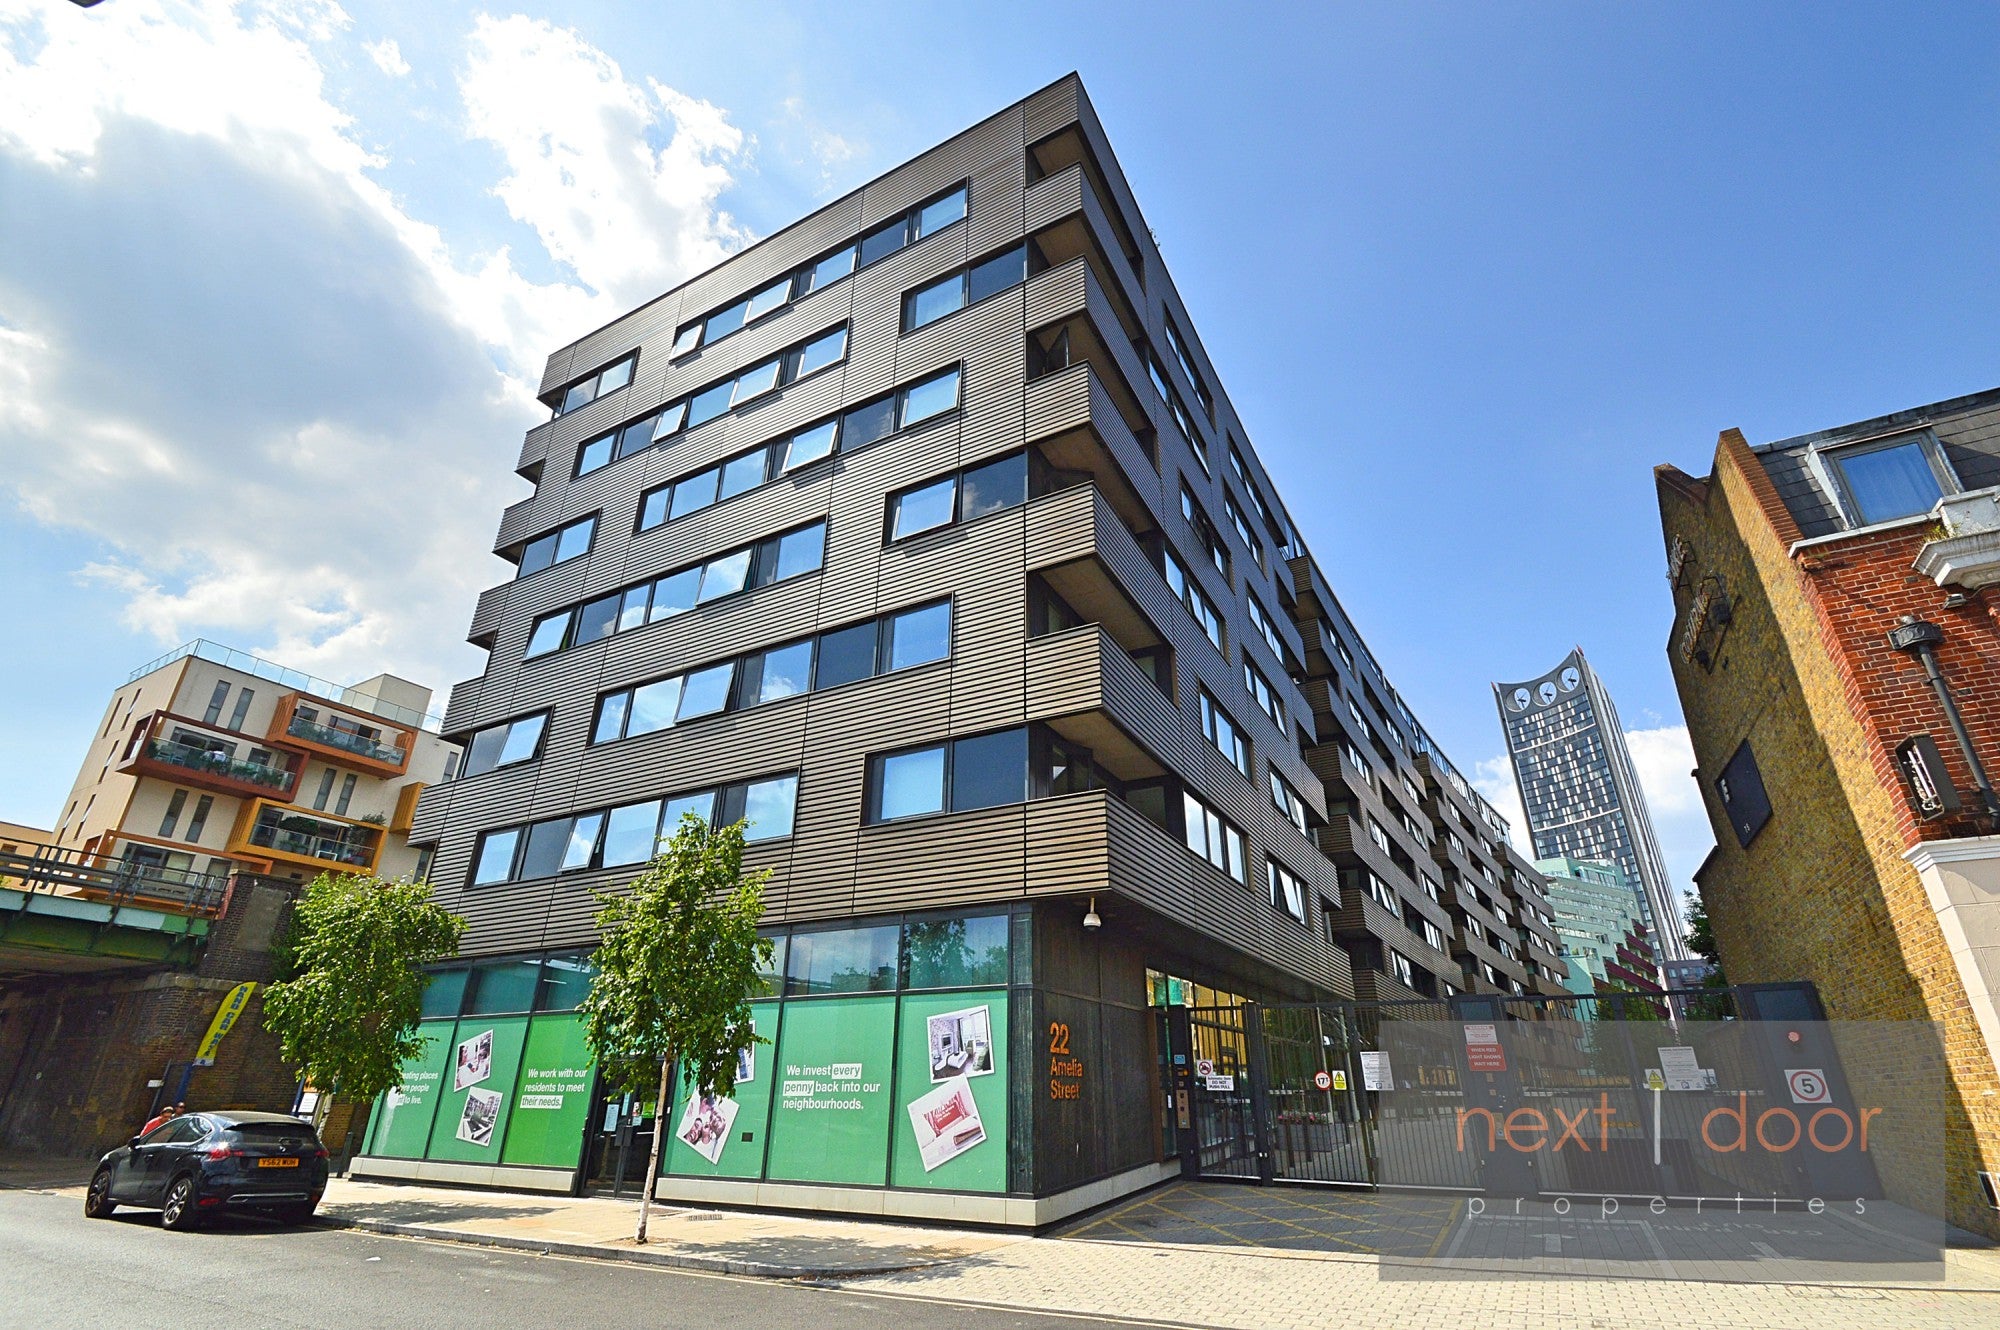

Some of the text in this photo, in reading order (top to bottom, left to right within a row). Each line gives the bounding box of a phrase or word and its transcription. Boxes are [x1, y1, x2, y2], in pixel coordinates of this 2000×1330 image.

[1050, 1022, 1070, 1054] 22
[528, 1068, 588, 1078] We work with our
[786, 1064, 860, 1077] We invest every
[1050, 1056, 1083, 1077] Amelia
[419, 1071, 439, 1080] places
[410, 1083, 430, 1093] people
[524, 1083, 586, 1092] residents to meet
[784, 1081, 881, 1094] penny back into our
[1050, 1079, 1080, 1100] Street
[1801, 1078, 1815, 1094] 5
[522, 1097, 561, 1107] their needs.
[782, 1098, 865, 1111] neighbourhoods.
